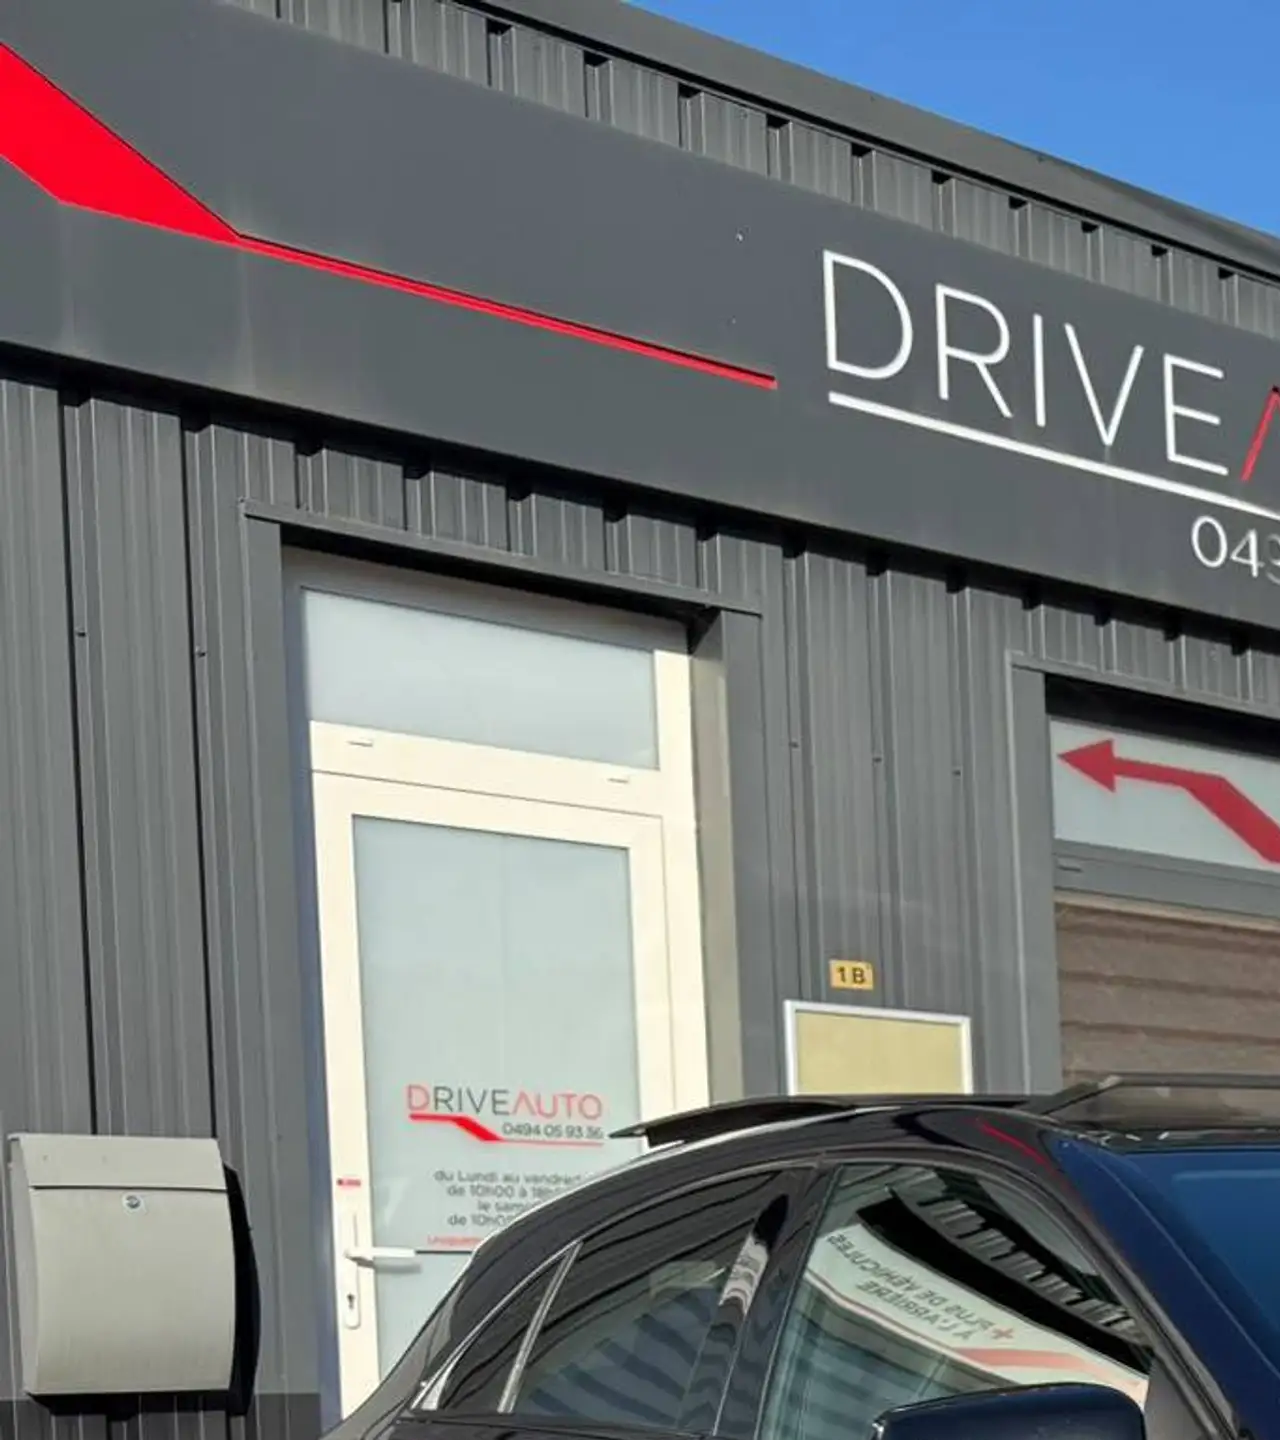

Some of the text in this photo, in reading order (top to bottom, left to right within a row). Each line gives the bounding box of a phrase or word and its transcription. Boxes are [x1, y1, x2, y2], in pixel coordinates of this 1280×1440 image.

[502, 1122, 541, 1137] 0494
[544, 1124, 562, 1138] 05
[565, 1125, 583, 1139] 93
[434, 1170, 454, 1182] du
[446, 1185, 466, 1196] de
[446, 1214, 467, 1226] de
